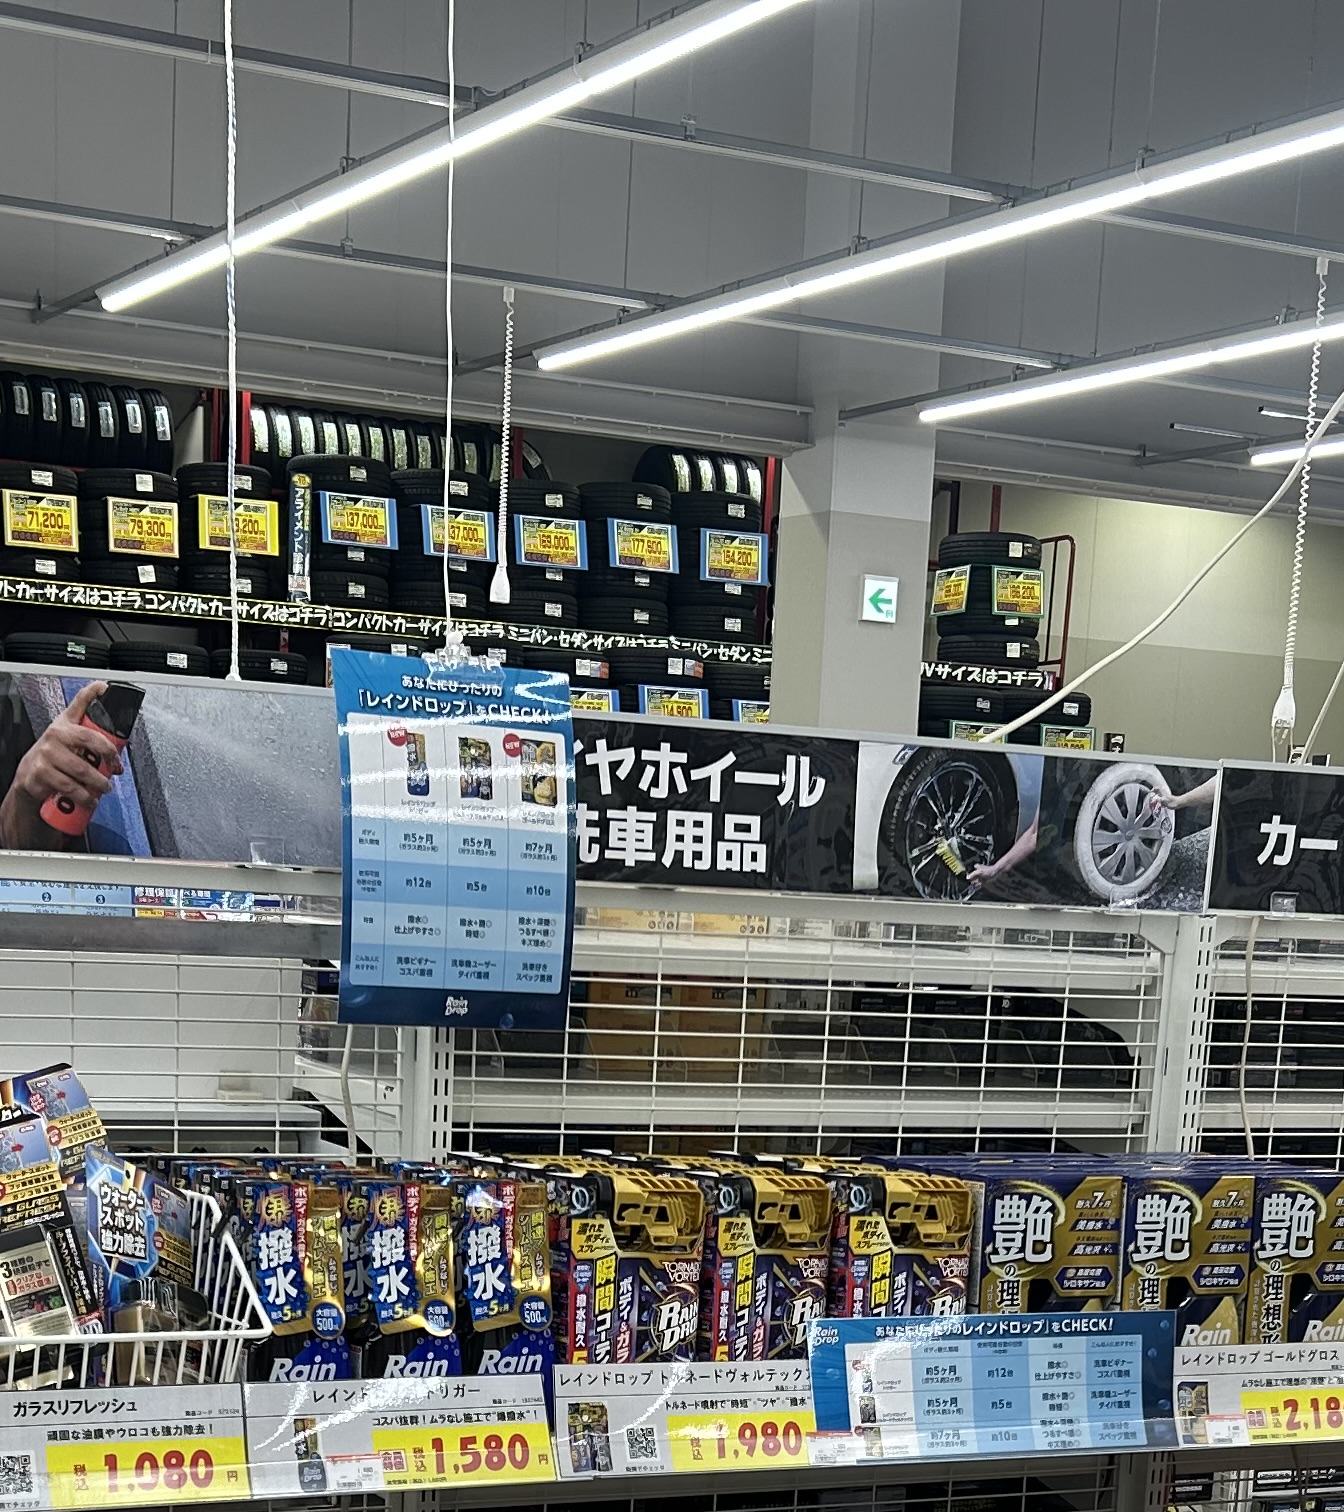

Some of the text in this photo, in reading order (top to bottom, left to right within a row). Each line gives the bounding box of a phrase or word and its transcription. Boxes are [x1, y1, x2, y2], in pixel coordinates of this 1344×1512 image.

[99, 1186, 145, 1209] ウォーター
[269, 1357, 337, 1382] Rain
[478, 1349, 543, 1374] Rain
[1182, 1349, 1340, 1366] レインドロップ ゴールドグロス
[560, 1370, 654, 1387] レインドロップ
[13, 1398, 138, 1418] ガラスリフレッシュ
[431, 1433, 530, 1475] 1,580
[104, 1449, 215, 1493] 1,080
